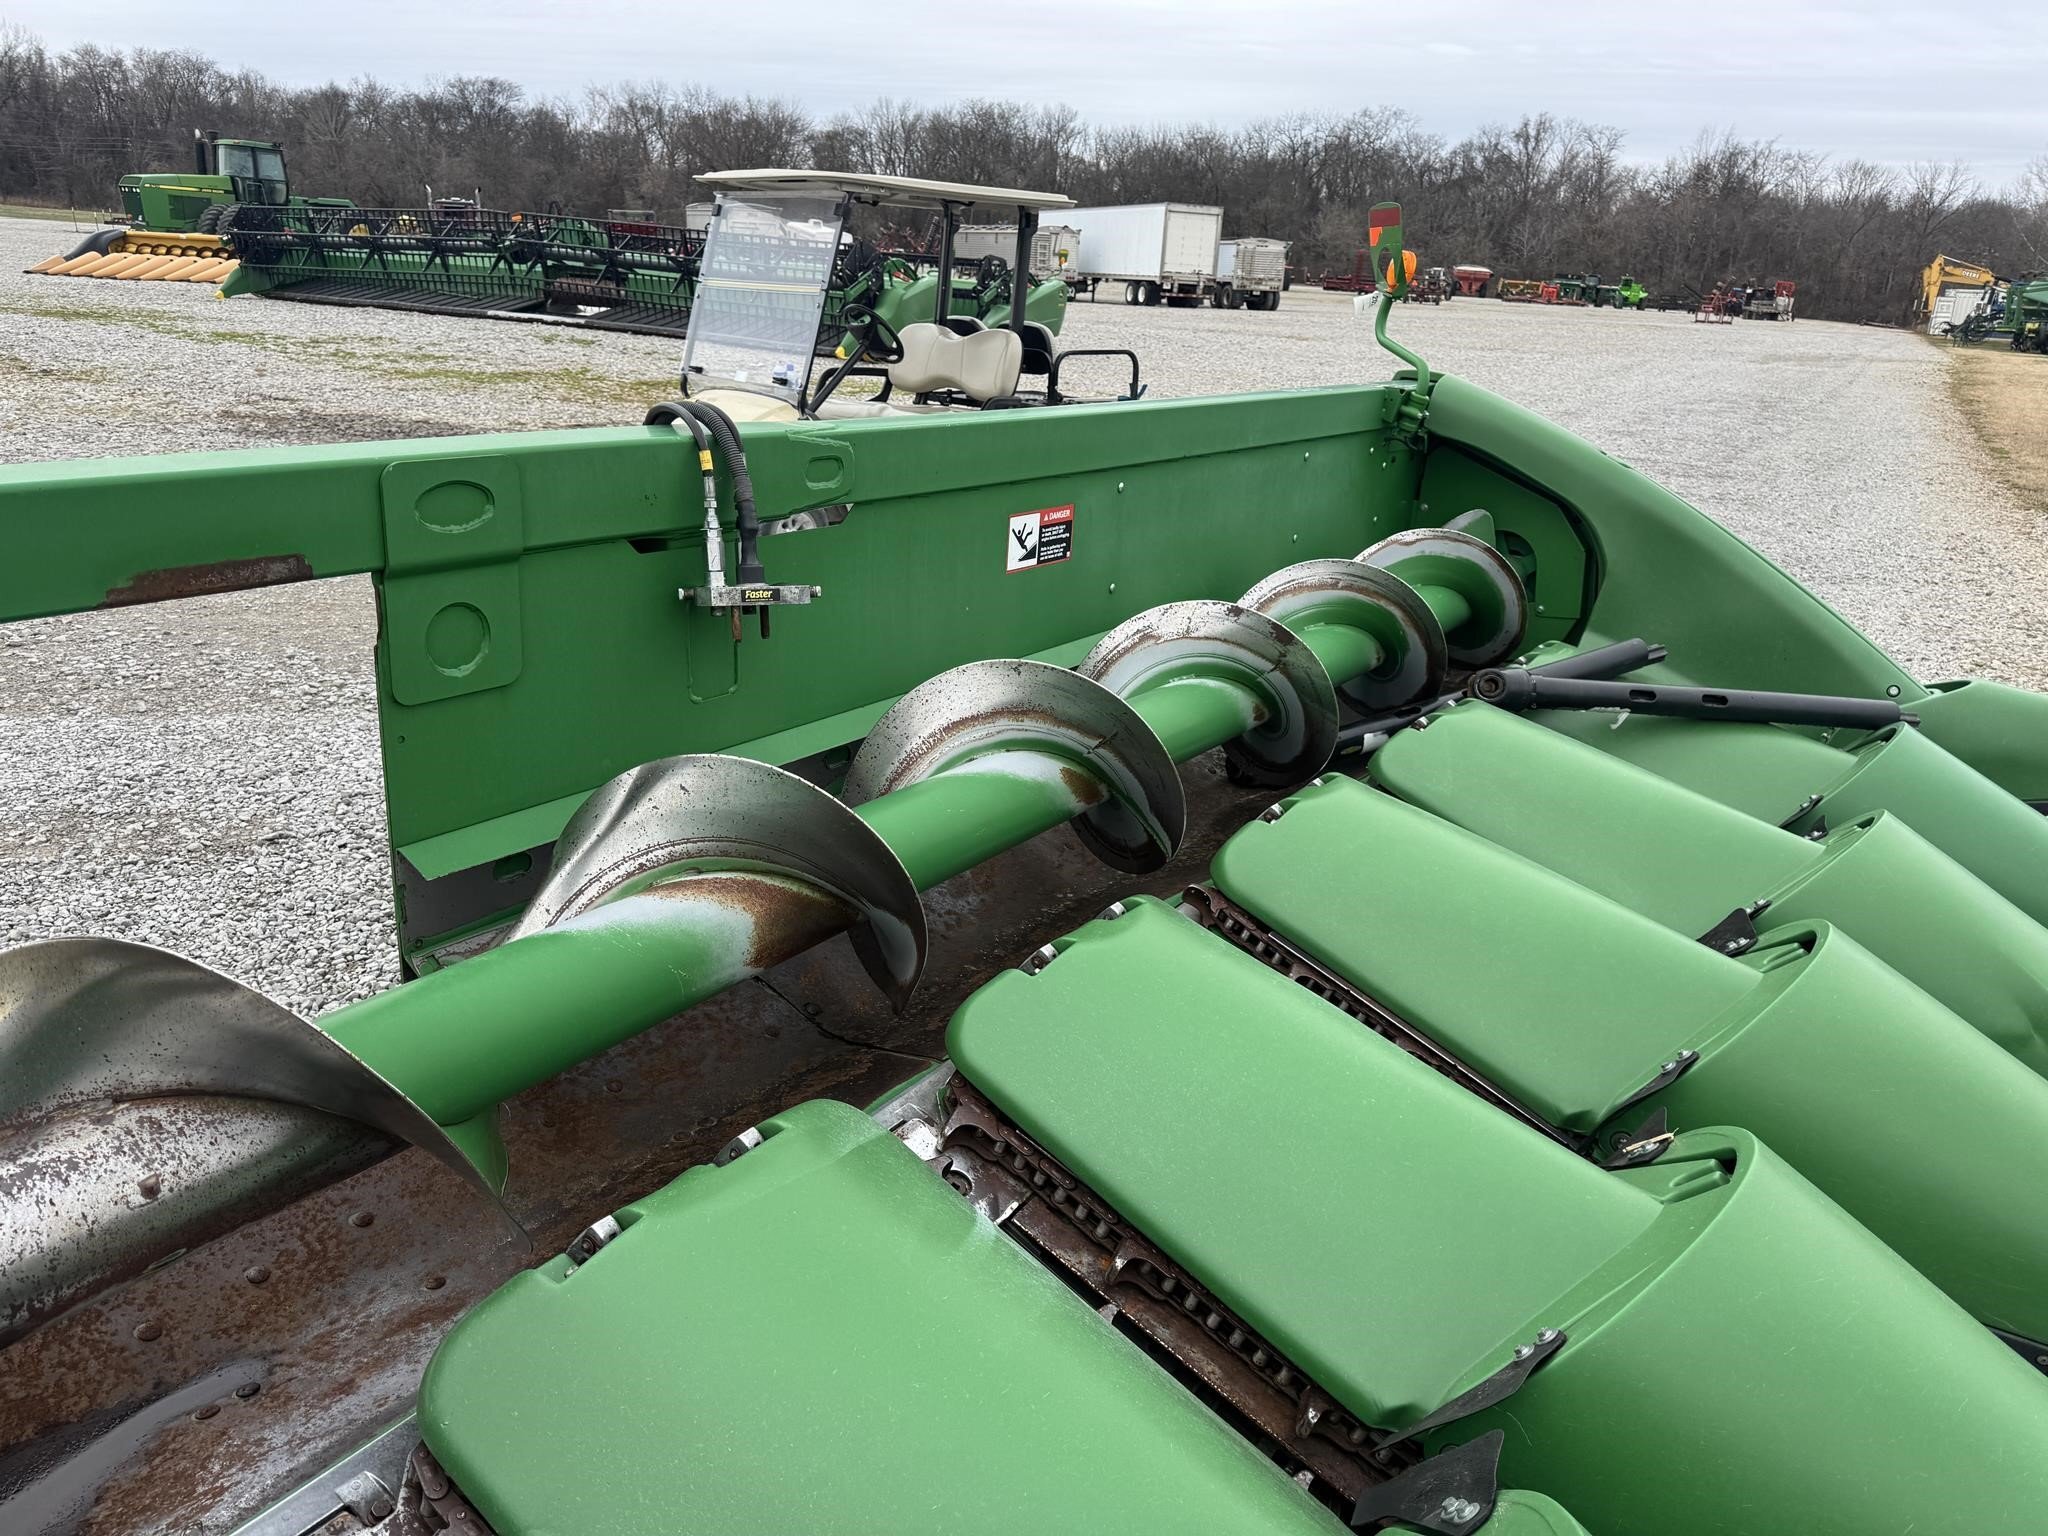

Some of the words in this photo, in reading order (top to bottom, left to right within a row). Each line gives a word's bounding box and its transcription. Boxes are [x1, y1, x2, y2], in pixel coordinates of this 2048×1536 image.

[1962, 270, 1980, 279] DEERE
[1049, 509, 1071, 520] DANGER
[745, 590, 773, 598] Faster
